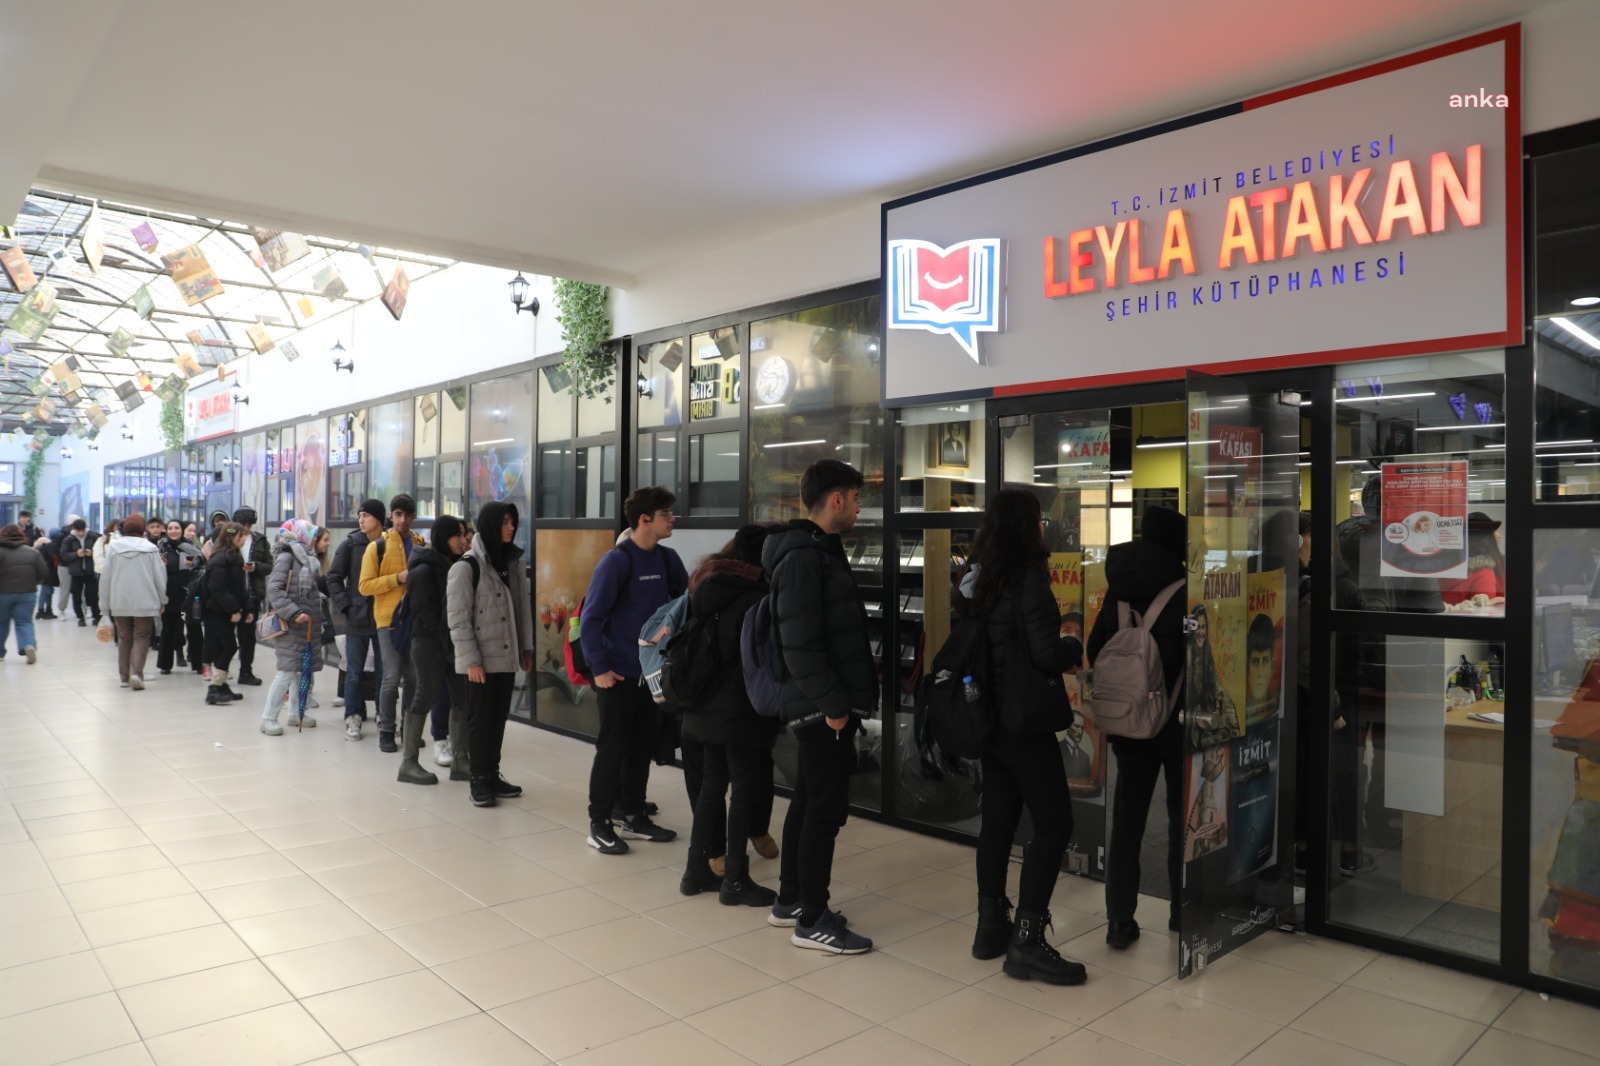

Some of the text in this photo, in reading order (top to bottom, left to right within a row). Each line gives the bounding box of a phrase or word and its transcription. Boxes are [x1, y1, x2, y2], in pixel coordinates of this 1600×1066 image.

[1111, 134, 1394, 215] T.C. İZMİT BELEDİYESİ
[1043, 144, 1482, 299] LEYLA ATAKAN
[1105, 251, 1405, 322] ŞEHİR KÜTÜPHANESİ
[1203, 571, 1241, 600] ATAKAN
